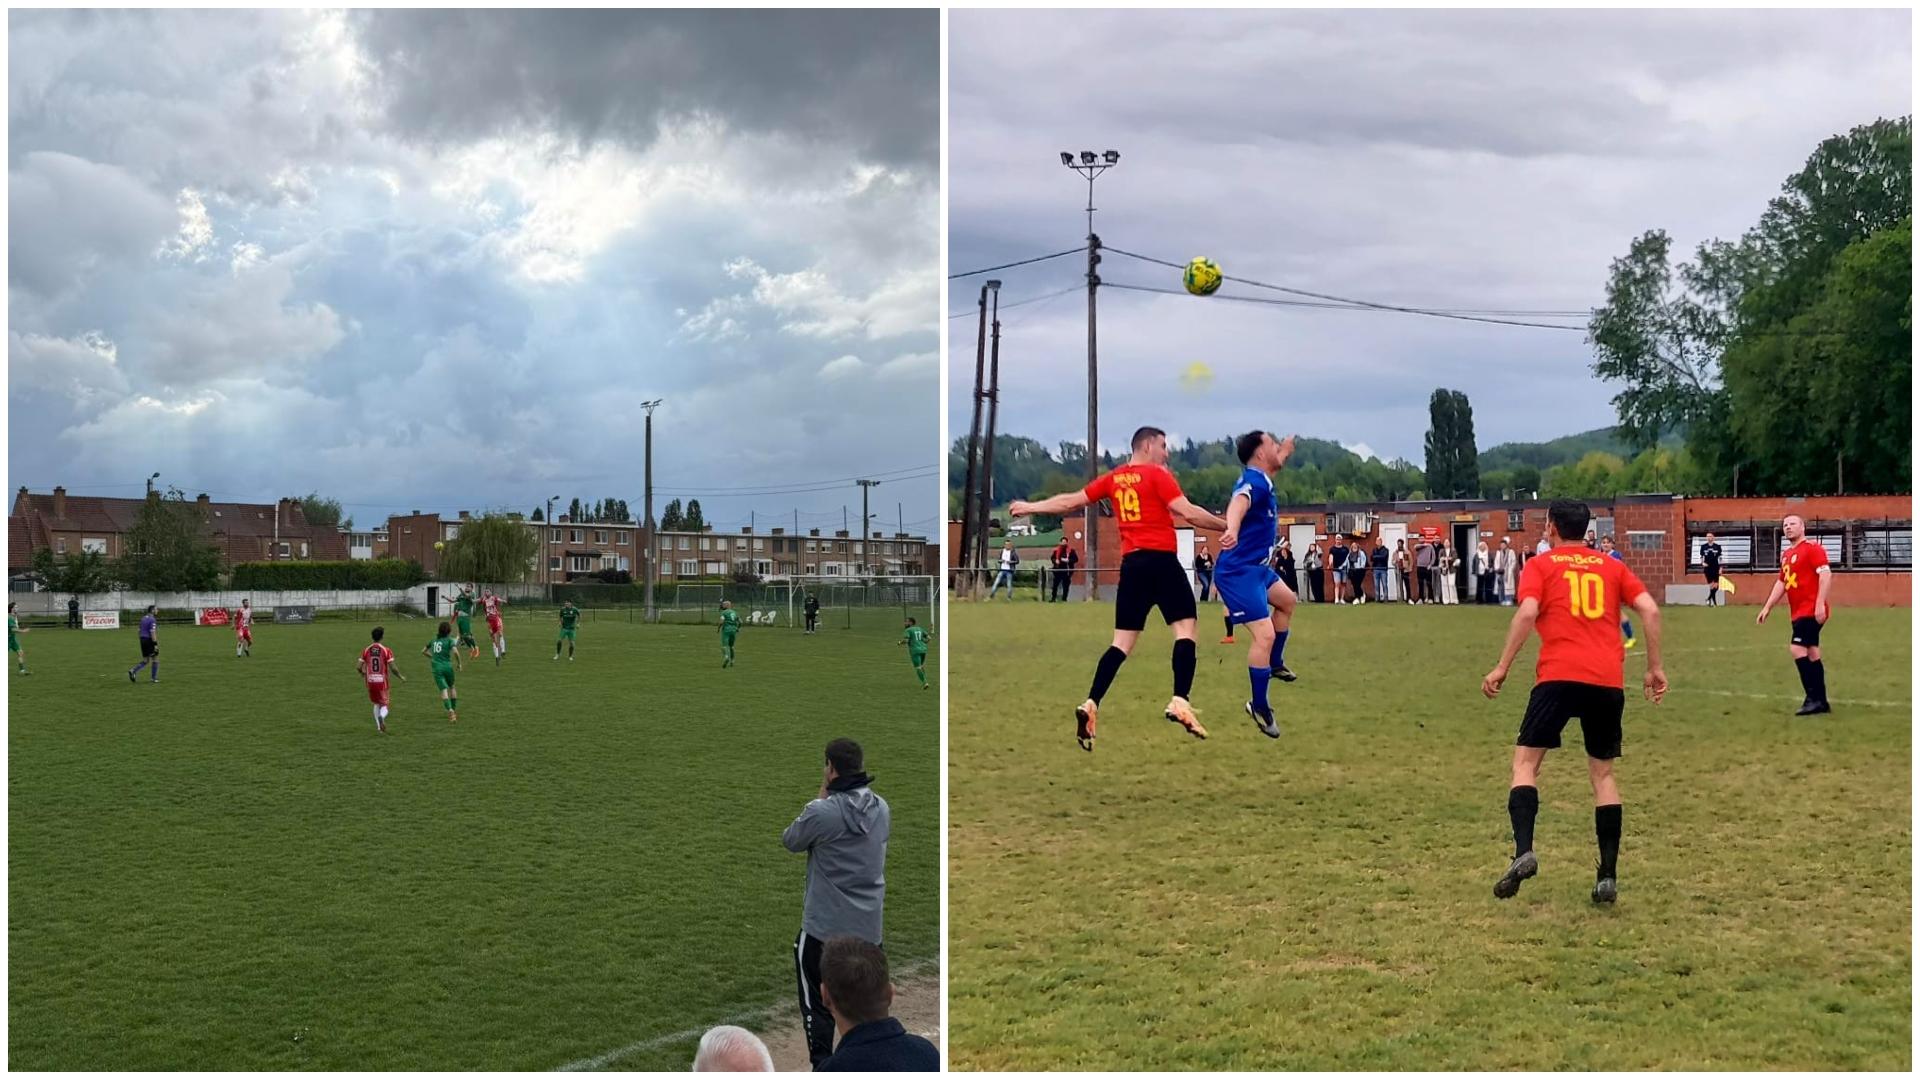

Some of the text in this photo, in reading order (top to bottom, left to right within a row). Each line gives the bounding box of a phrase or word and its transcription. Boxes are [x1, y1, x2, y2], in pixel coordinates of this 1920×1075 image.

[1115, 488, 1141, 521] 19
[1563, 571, 1604, 619] 10
[433, 641, 442, 653] 16
[371, 657, 380, 673] 8
